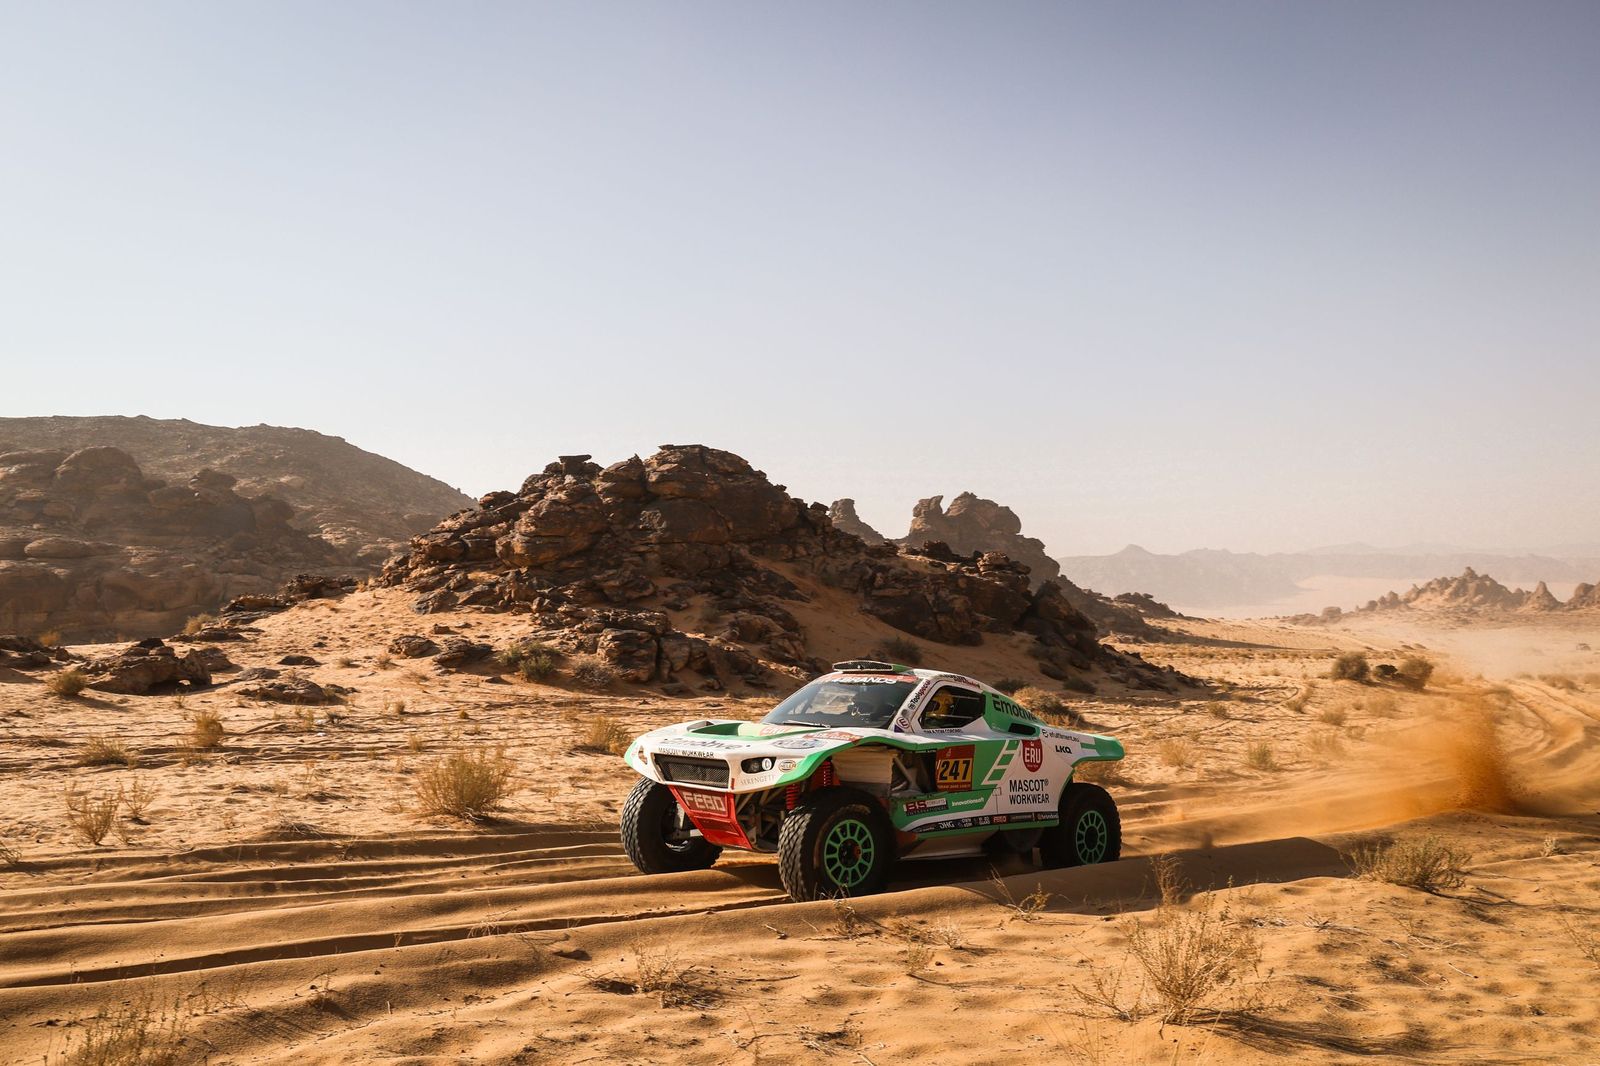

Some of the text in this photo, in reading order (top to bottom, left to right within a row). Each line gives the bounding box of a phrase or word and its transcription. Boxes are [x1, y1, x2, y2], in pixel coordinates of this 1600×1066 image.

[1024, 747, 1041, 763] ERU
[1055, 745, 1072, 754] LKQ
[939, 760, 971, 781] 247
[682, 791, 726, 811] FEBO
[1009, 794, 1050, 805] WORKWEAR
